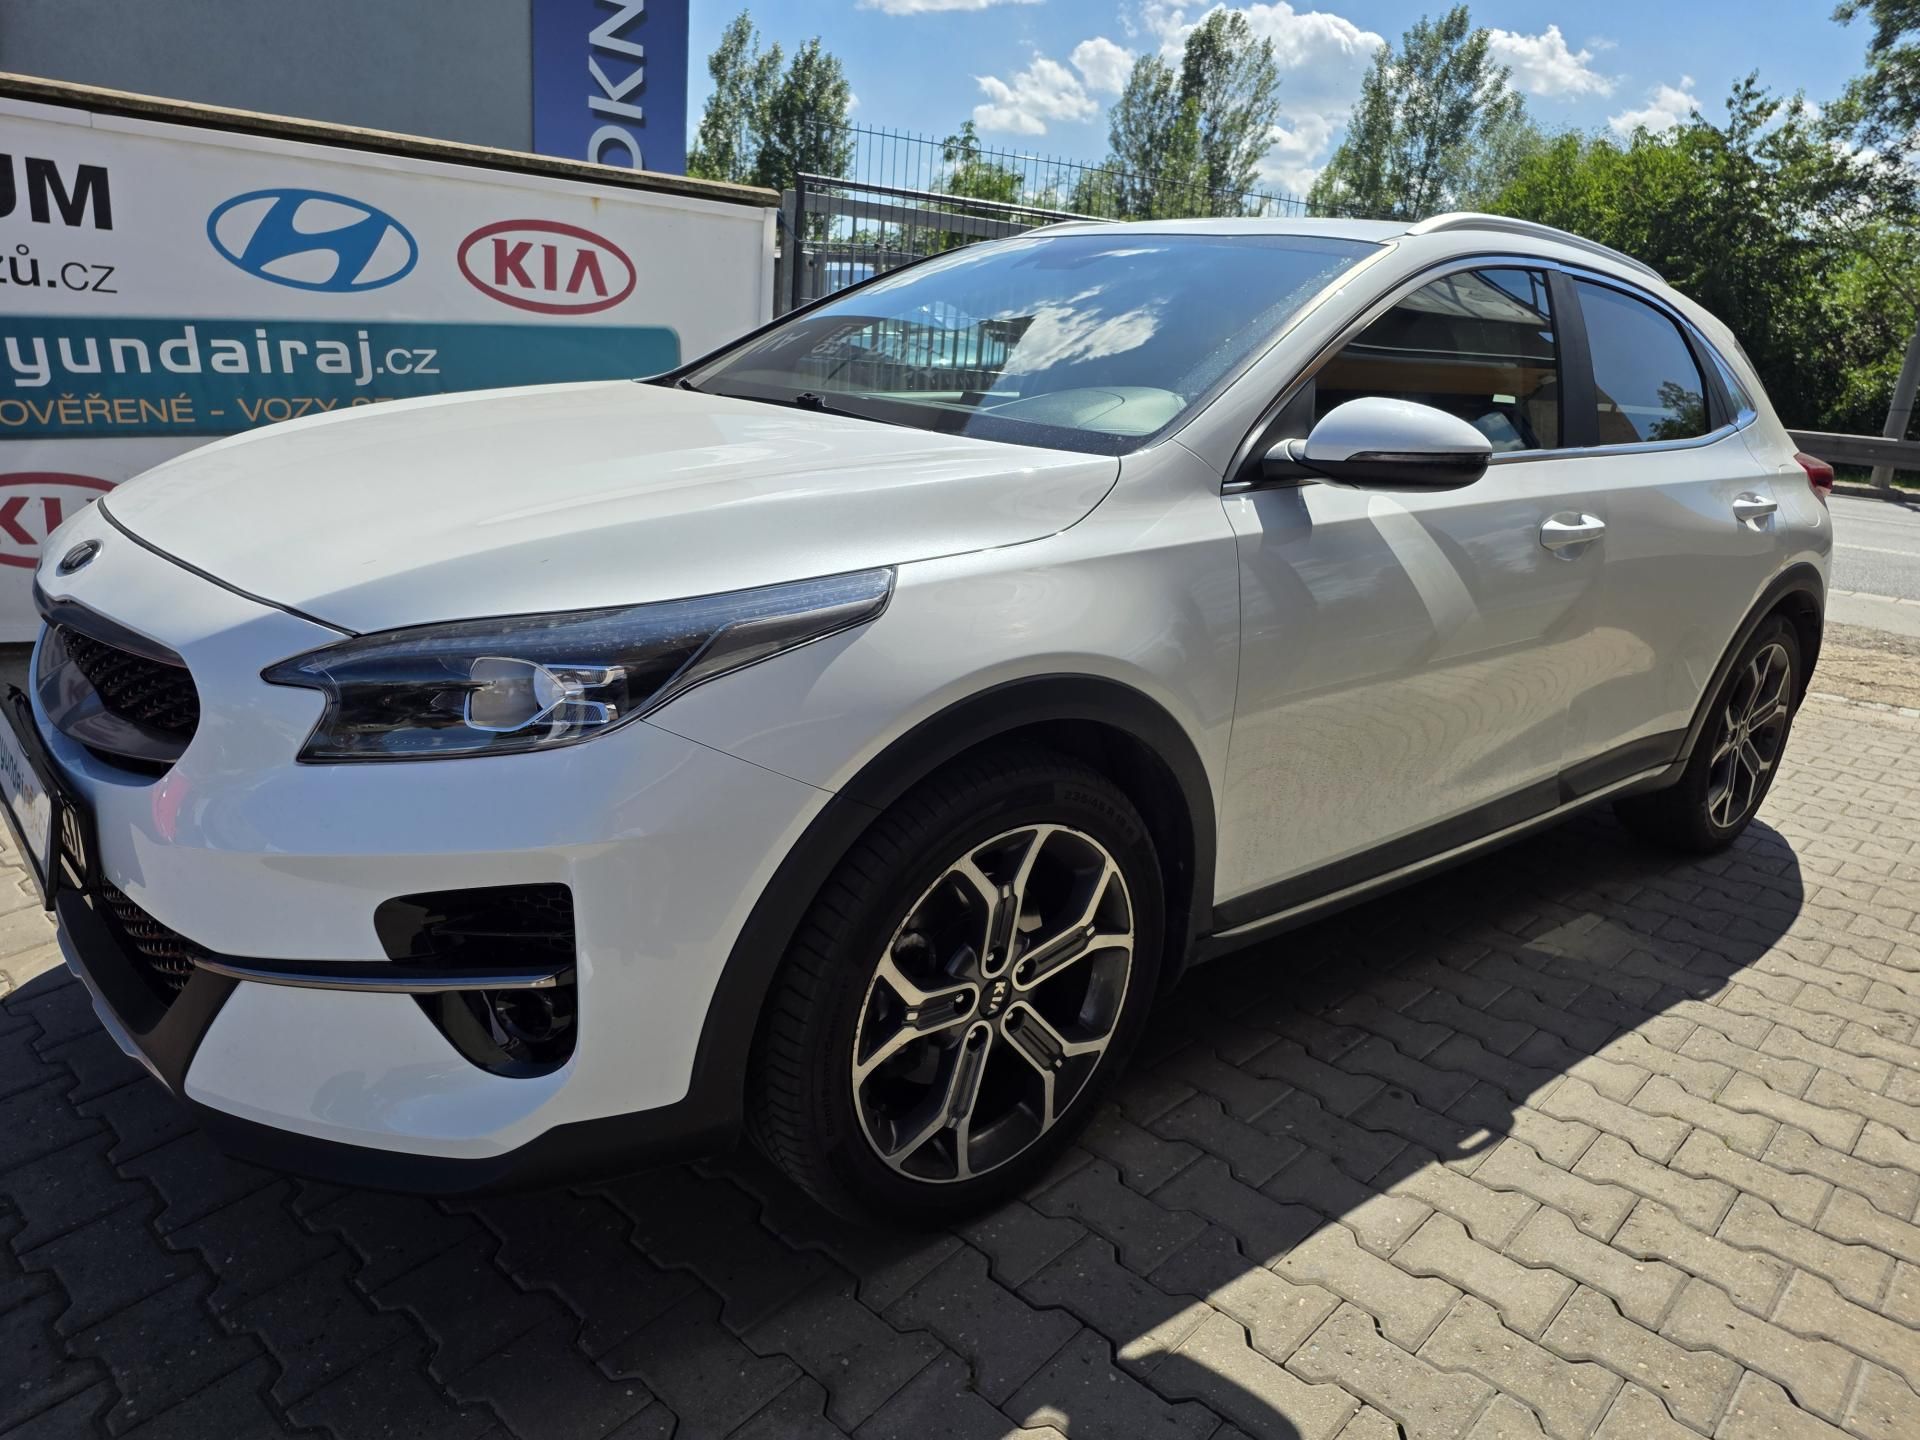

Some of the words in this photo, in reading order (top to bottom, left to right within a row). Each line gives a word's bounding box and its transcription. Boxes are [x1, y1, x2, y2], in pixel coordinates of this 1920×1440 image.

[0, 244, 118, 293] ů.cz
[491, 238, 608, 297] KIA
[4, 325, 440, 387] yundairaj.cz
[0, 392, 196, 426] OVĚŘENÉ
[0, 497, 97, 545] KI
[987, 981, 1006, 1016] KIA
